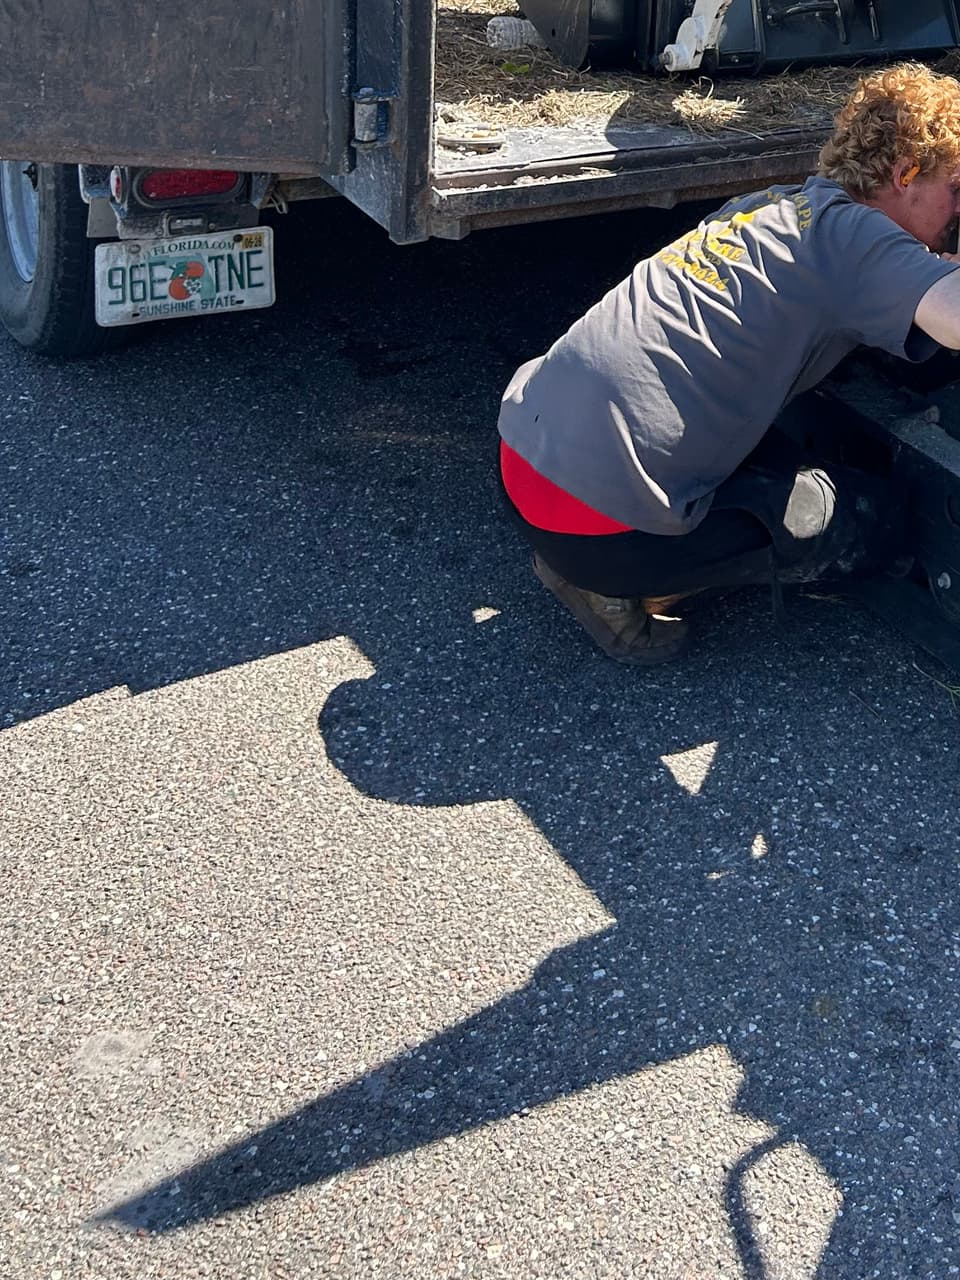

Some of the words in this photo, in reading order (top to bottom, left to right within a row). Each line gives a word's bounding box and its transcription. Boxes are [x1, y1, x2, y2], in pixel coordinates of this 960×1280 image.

[107, 261, 168, 305] 96E
[208, 250, 264, 293] TNE
[140, 300, 197, 317] SUNSHINE
[200, 295, 237, 310] STATE
